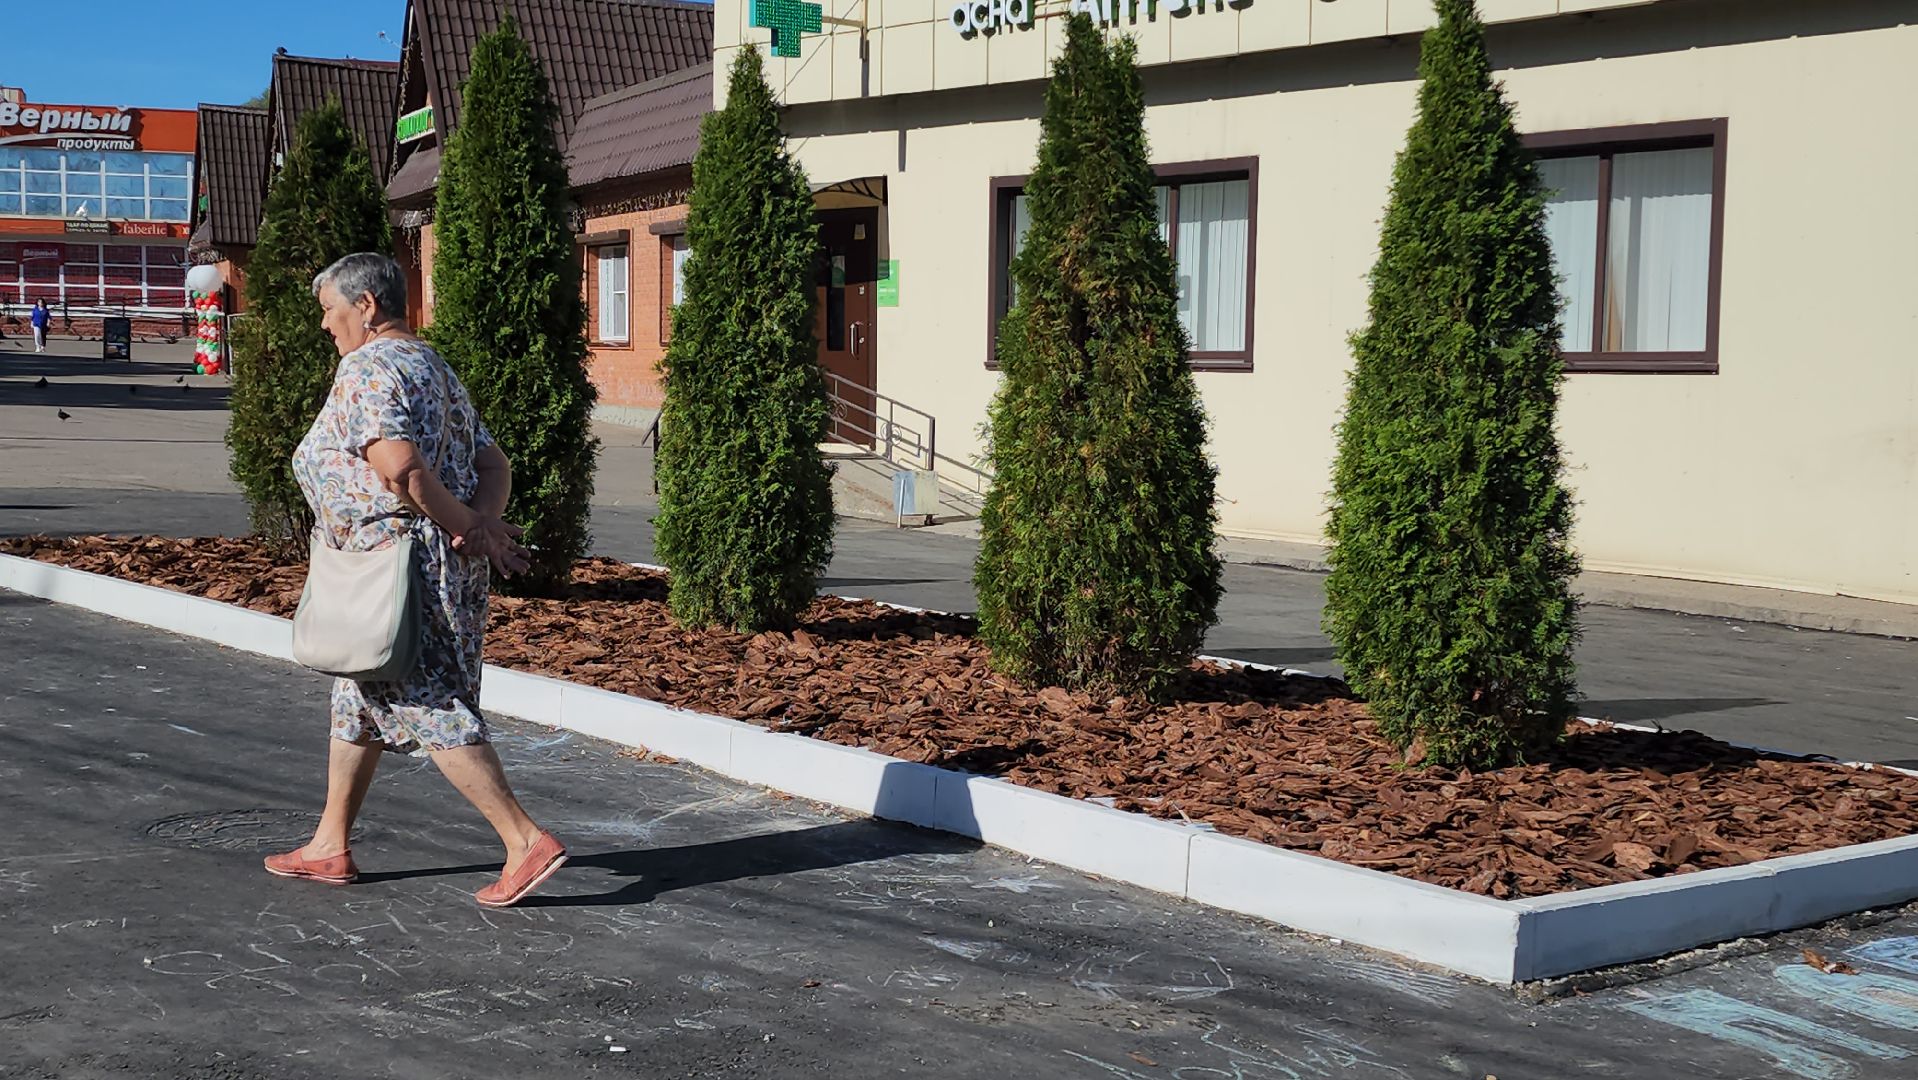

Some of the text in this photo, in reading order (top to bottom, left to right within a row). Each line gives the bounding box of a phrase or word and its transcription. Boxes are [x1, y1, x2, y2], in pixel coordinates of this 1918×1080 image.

[0, 102, 132, 133] Верный
[57, 138, 135, 151] продукты
[122, 223, 167, 236] faberlic
